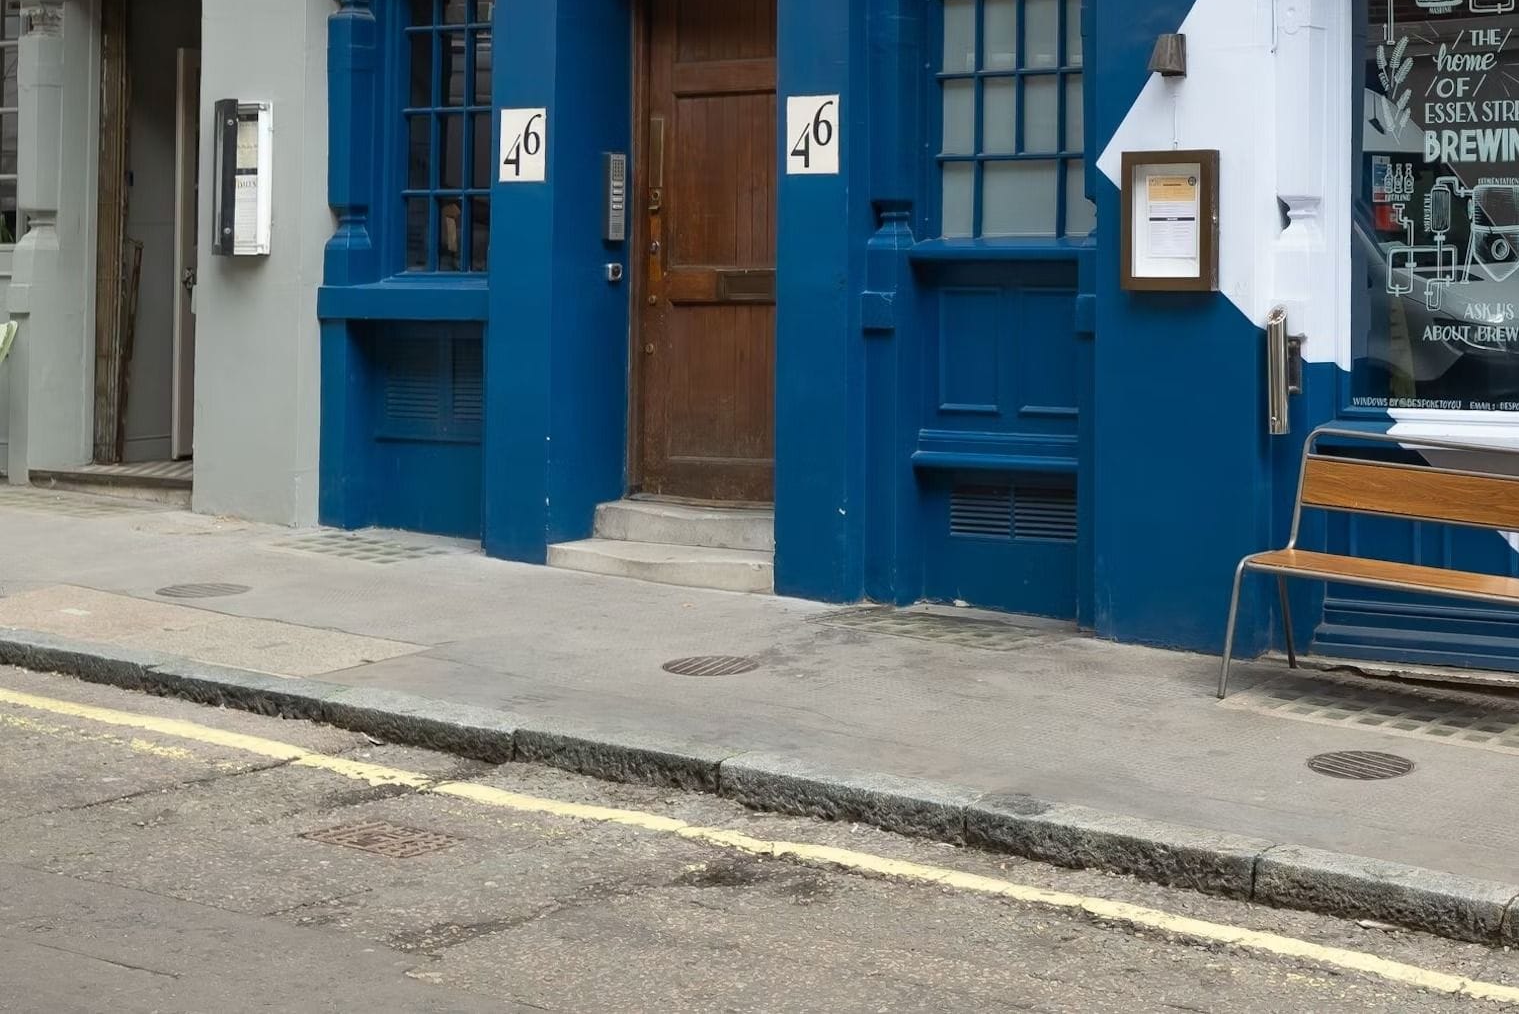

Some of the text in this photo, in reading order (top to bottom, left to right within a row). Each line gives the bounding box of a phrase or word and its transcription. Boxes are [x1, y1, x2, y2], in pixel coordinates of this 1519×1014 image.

[1469, 29, 1501, 47] THE
[1433, 43, 1497, 72] home
[1436, 77, 1471, 98] OF
[1425, 102, 1478, 124] ESSEX
[503, 113, 542, 176] 46
[790, 101, 833, 168] 46
[1464, 304, 1491, 320] ASK
[1496, 303, 1514, 321] US
[1423, 325, 1471, 341] ABOUT
[1352, 397, 1388, 407] WINDOWS
[1388, 398, 1399, 408] BY
